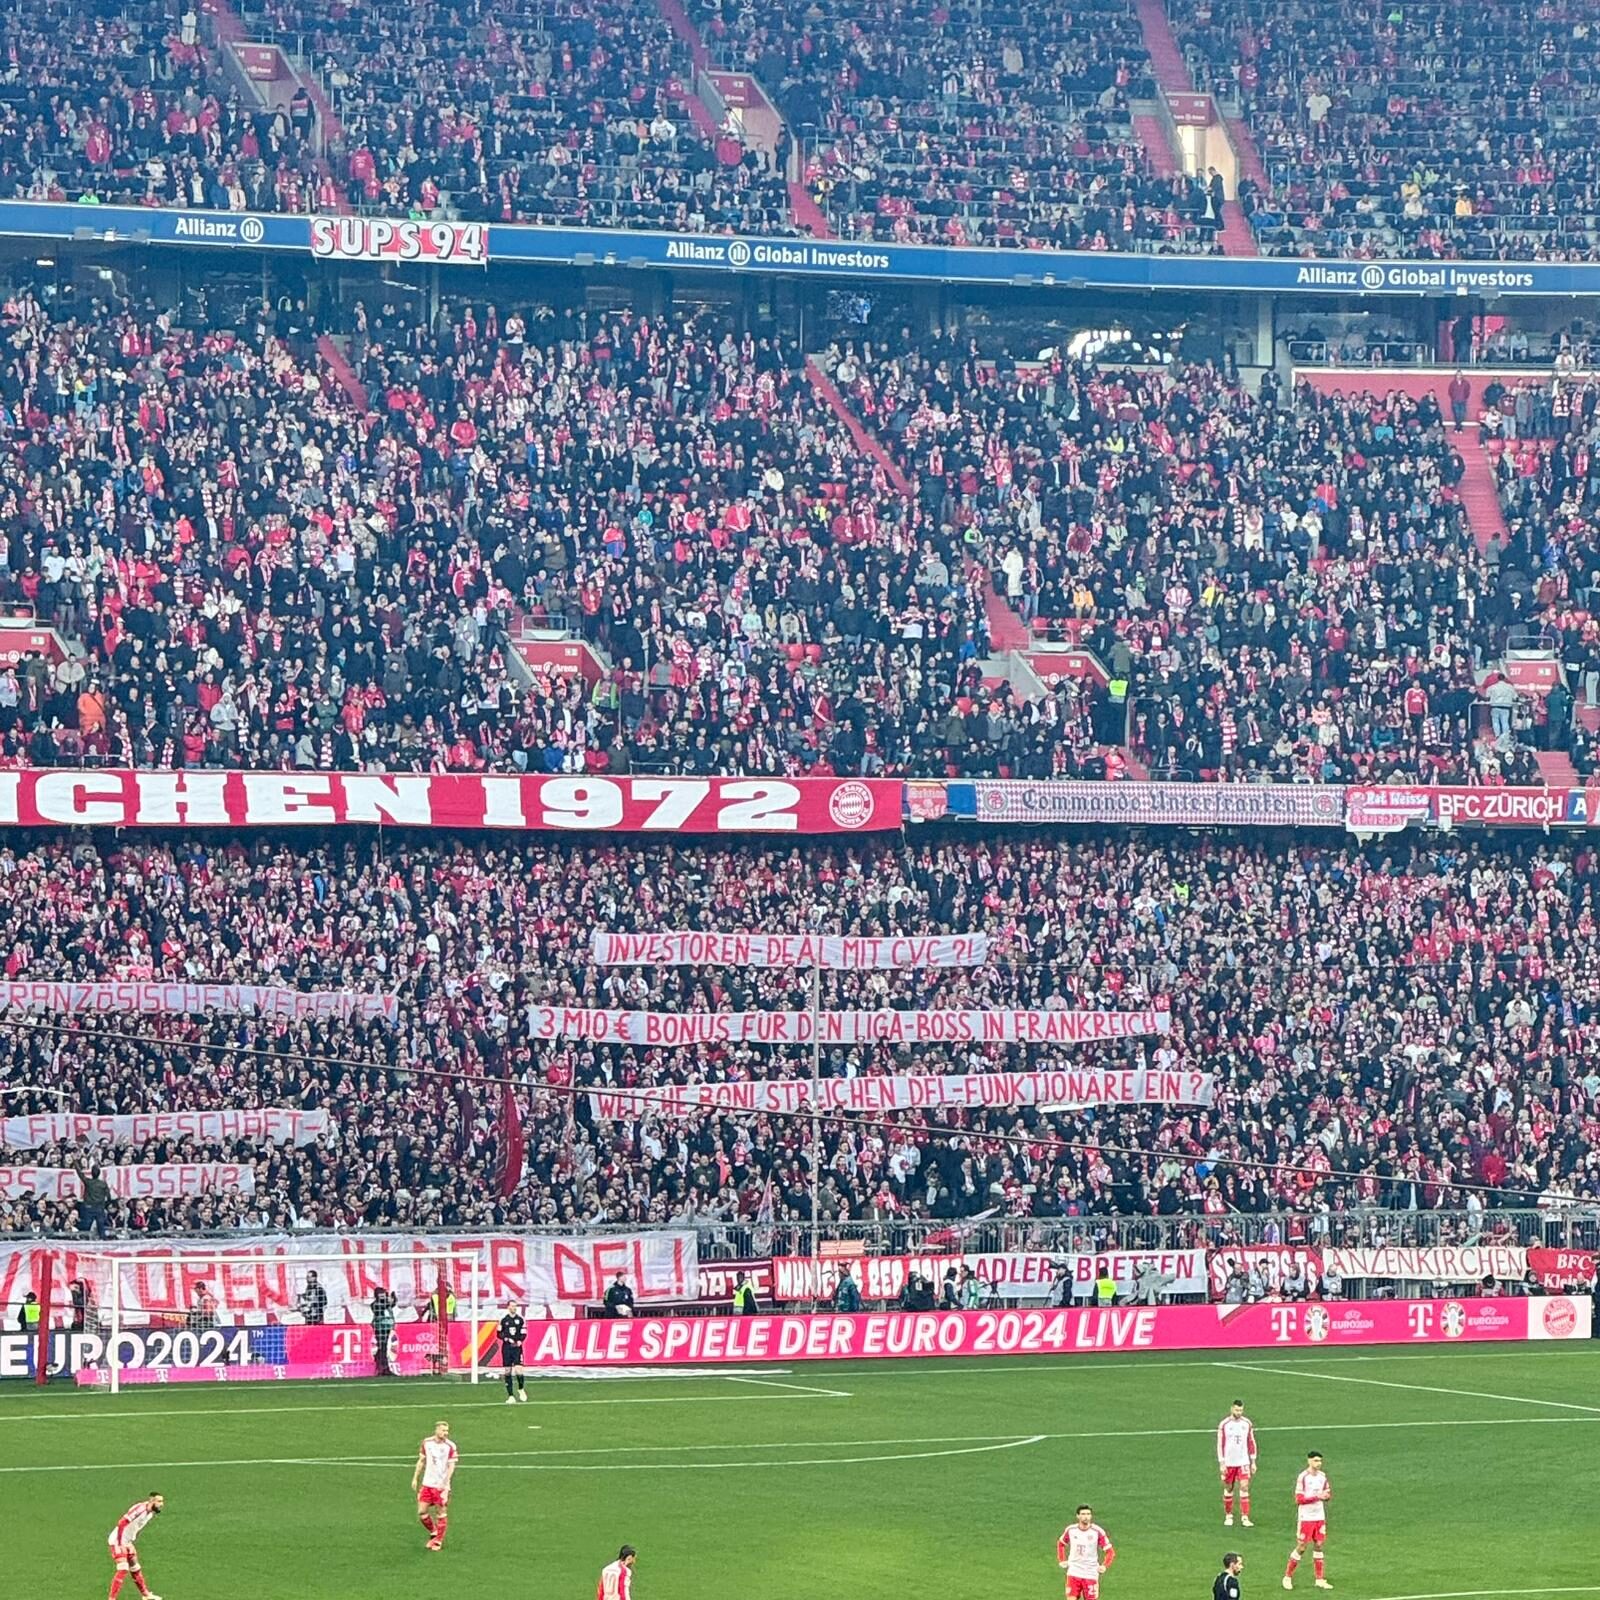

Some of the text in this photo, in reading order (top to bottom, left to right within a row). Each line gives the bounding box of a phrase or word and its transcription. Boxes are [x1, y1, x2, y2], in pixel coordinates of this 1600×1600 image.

[175, 218, 236, 237] Allianz
[313, 218, 485, 260] SUPS 94
[666, 241, 889, 269] Allianz Global Investors
[1297, 268, 1533, 289] Allianz Global Investors
[481, 777, 801, 831] 1972
[1022, 789, 1141, 811] Commando
[1149, 790, 1297, 814] Unterfranken
[1438, 792, 1563, 819] BFC ZÜRICH
[608, 934, 830, 966] INVESTOREN-DEAL
[843, 938, 883, 967] MIT
[891, 938, 941, 966] CVC
[538, 1009, 1159, 1044] 3 MIO € BONUS FÜR DEN LIGA-BOSS IN FRANKREICH
[1145, 1072, 1182, 1102] EIN
[553, 1239, 684, 1300] DFL!
[976, 1257, 1053, 1283] ADLER
[1333, 1248, 1524, 1276] ANZENKIRCHEN
[1557, 1254, 1592, 1270] BFC
[535, 1310, 1156, 1360] ALLE SPIELE DER EURO 2024 LIVE
[1271, 1307, 1296, 1341] T
[1408, 1304, 1433, 1337] T
[0, 1331, 252, 1375] EURO2024
[332, 1329, 361, 1363] T
